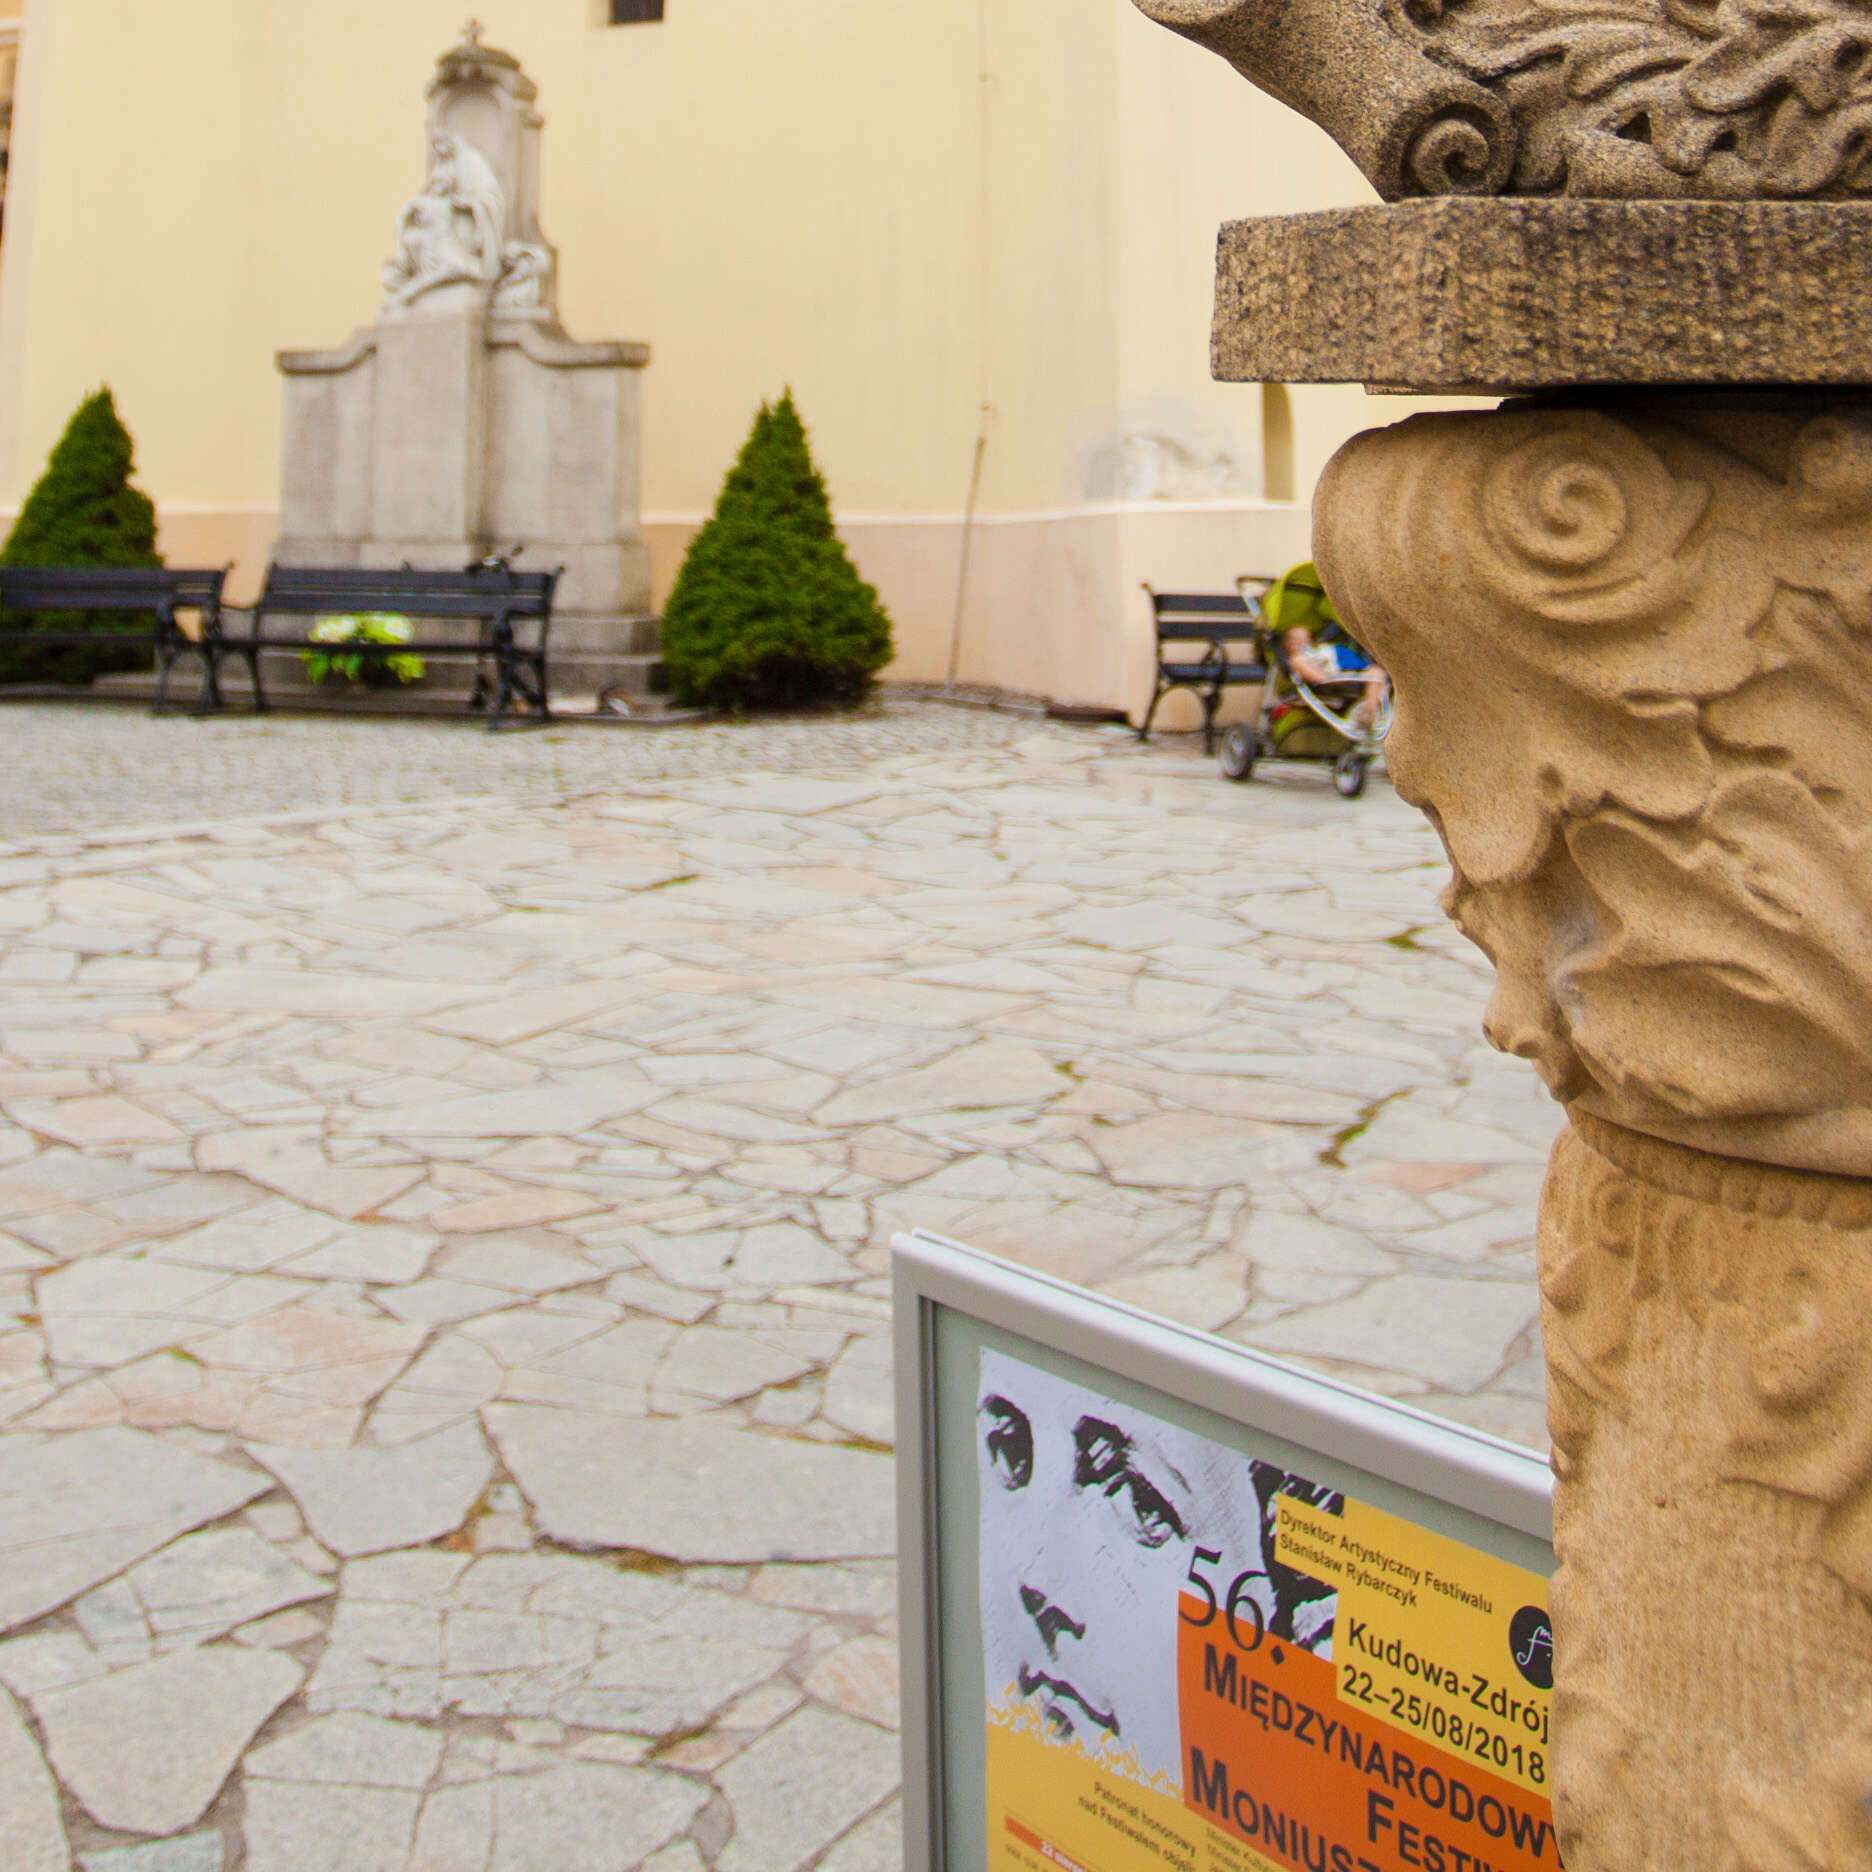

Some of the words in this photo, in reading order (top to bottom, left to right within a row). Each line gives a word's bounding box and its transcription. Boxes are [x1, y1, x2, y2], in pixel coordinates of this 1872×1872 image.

[1178, 1545, 1285, 1667] 56.
[1279, 1532, 1342, 1574] Stanisław
[1345, 1562, 1418, 1607] Rybarczyk
[1280, 1508, 1336, 1546] Dyrektor
[1340, 1535, 1421, 1586] Artystyczny
[1424, 1570, 1493, 1614] Festiwalu
[1348, 1617, 1549, 1745] Kudowa-Zdrój
[1191, 1744, 1381, 1872] MONIU
